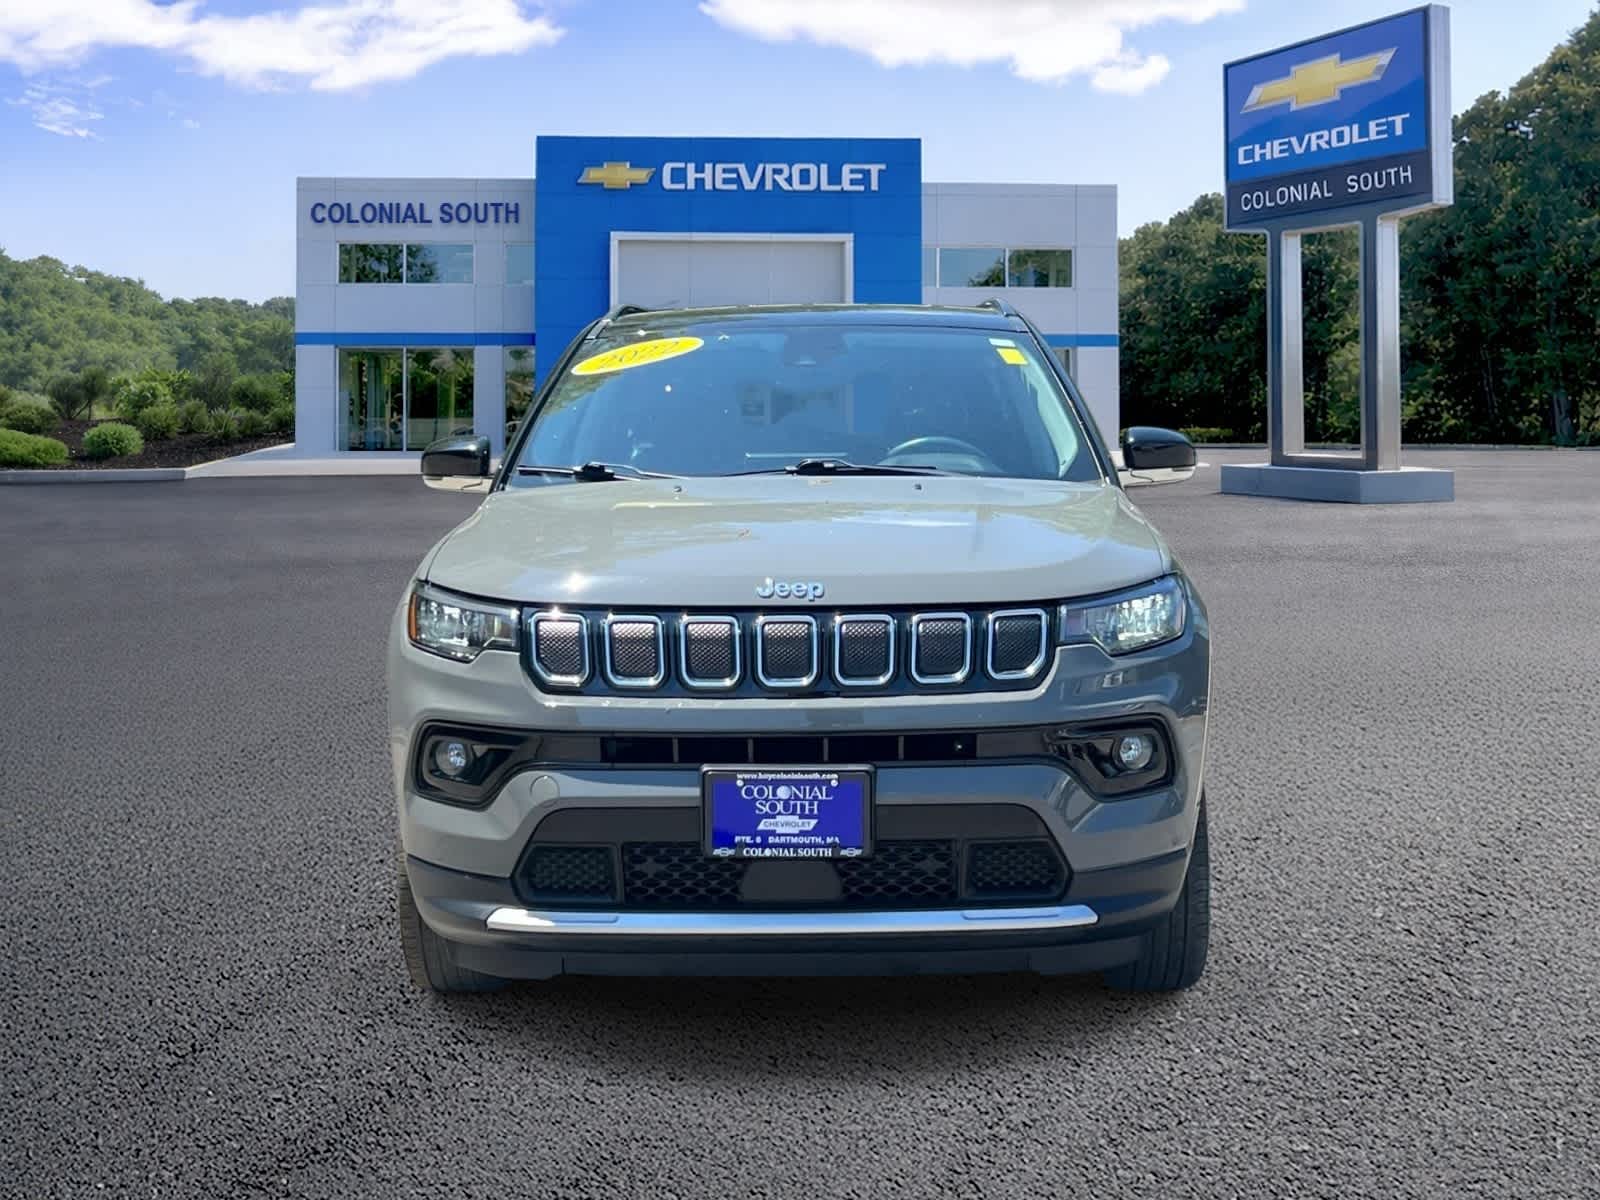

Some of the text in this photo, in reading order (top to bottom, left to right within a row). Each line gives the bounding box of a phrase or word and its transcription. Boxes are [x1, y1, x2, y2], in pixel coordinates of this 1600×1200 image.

[1238, 113, 1410, 165] CHEVROLET
[662, 162, 887, 192] CHEVROLET
[1241, 165, 1413, 212] COLONIAL SOUTH
[310, 202, 520, 225] COLONIAL SOUTH
[756, 577, 825, 602] Jeep
[741, 785, 833, 800] COLONIAL
[755, 800, 819, 814] SOUTH
[763, 820, 812, 828] CHEVROLET
[743, 848, 832, 857] COLONIAL SOUTH
